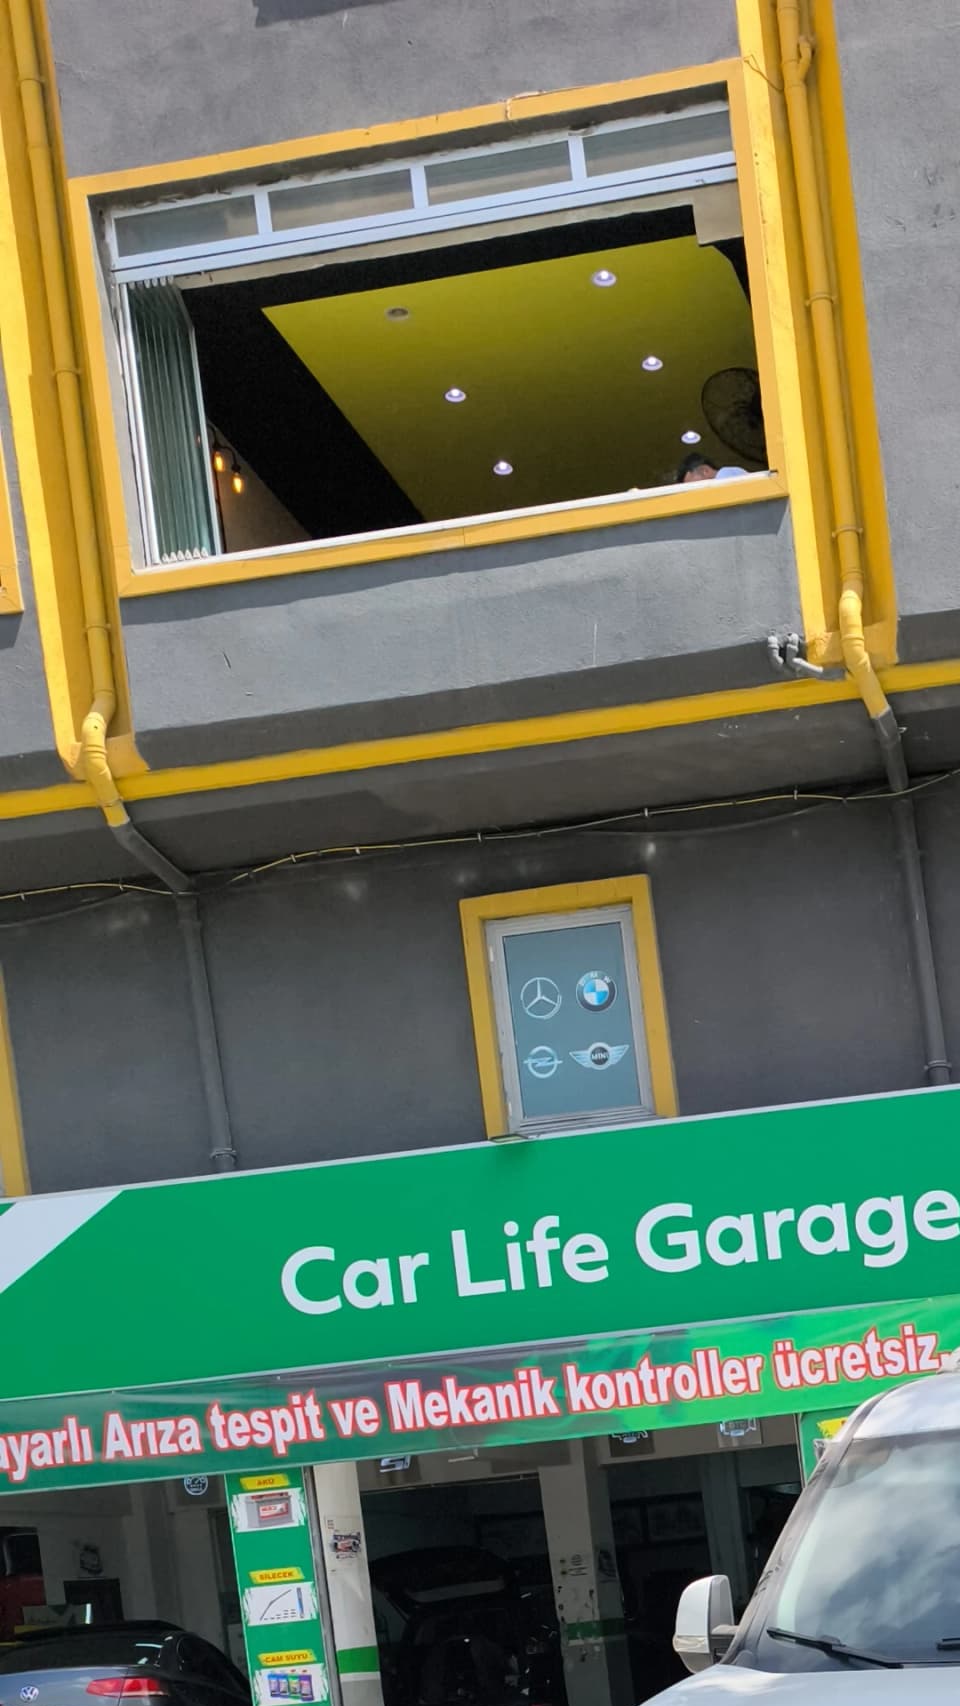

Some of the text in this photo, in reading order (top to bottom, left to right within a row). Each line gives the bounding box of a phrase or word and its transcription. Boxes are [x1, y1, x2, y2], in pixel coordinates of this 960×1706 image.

[281, 1190, 960, 1315] Car Life Garage
[103, 1412, 202, 1460] Arıza
[208, 1390, 325, 1455] tespit
[330, 1397, 380, 1438] ve
[385, 1367, 560, 1432] Mekanik
[564, 1350, 763, 1413] kontroller
